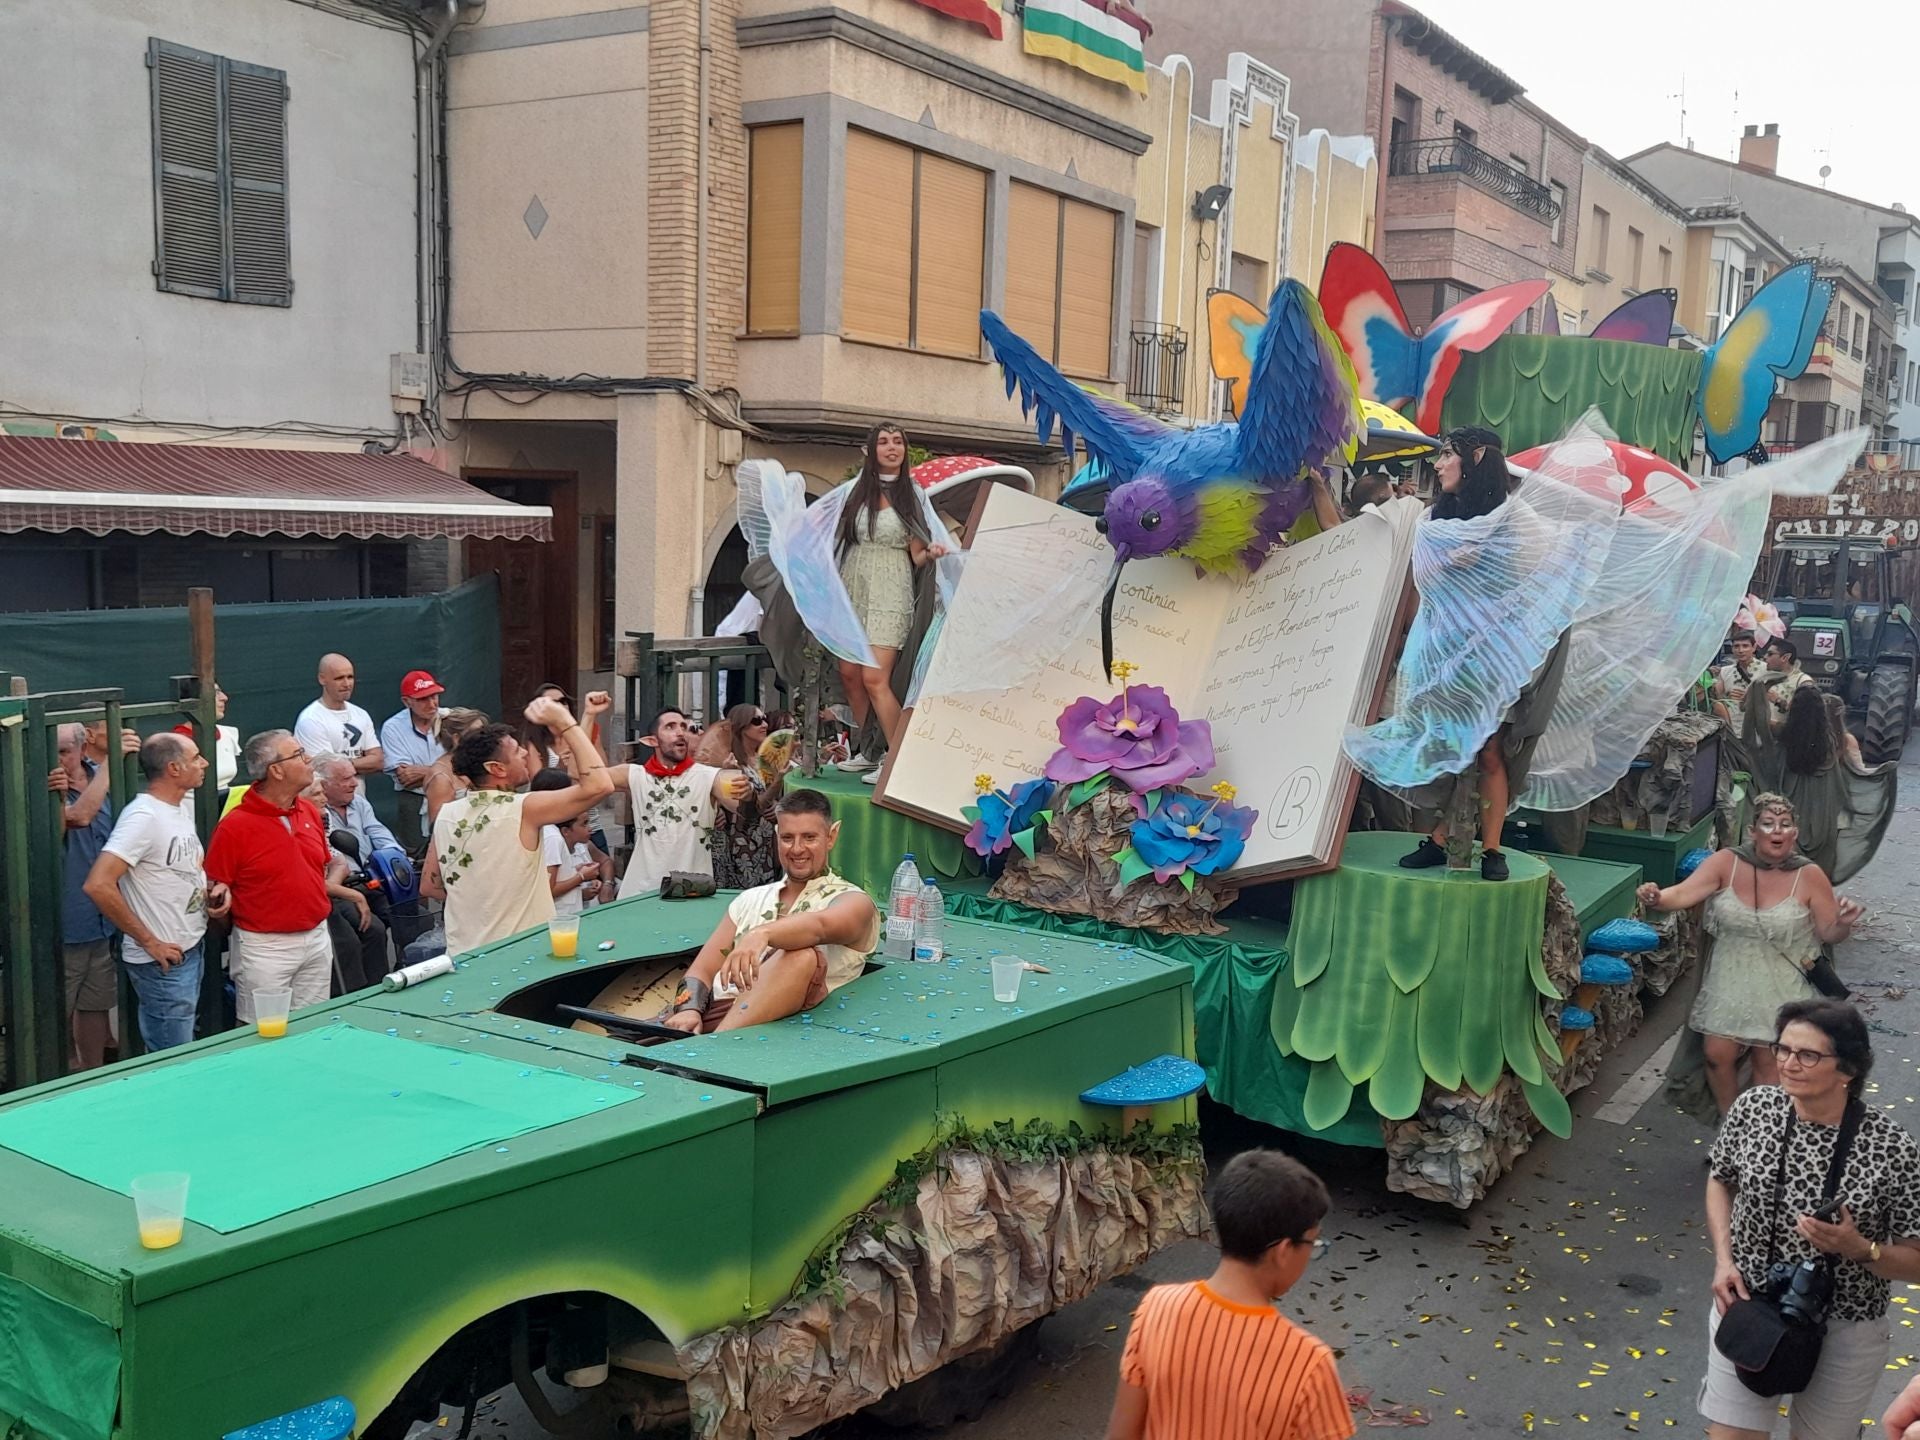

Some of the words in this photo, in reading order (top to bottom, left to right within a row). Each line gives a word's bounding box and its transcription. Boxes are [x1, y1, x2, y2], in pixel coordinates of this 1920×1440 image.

[1827, 494, 1865, 515] EL
[1775, 519, 1918, 542] CHINAZO
[1816, 637, 1834, 649] 32
[944, 727, 995, 770] Bosque
